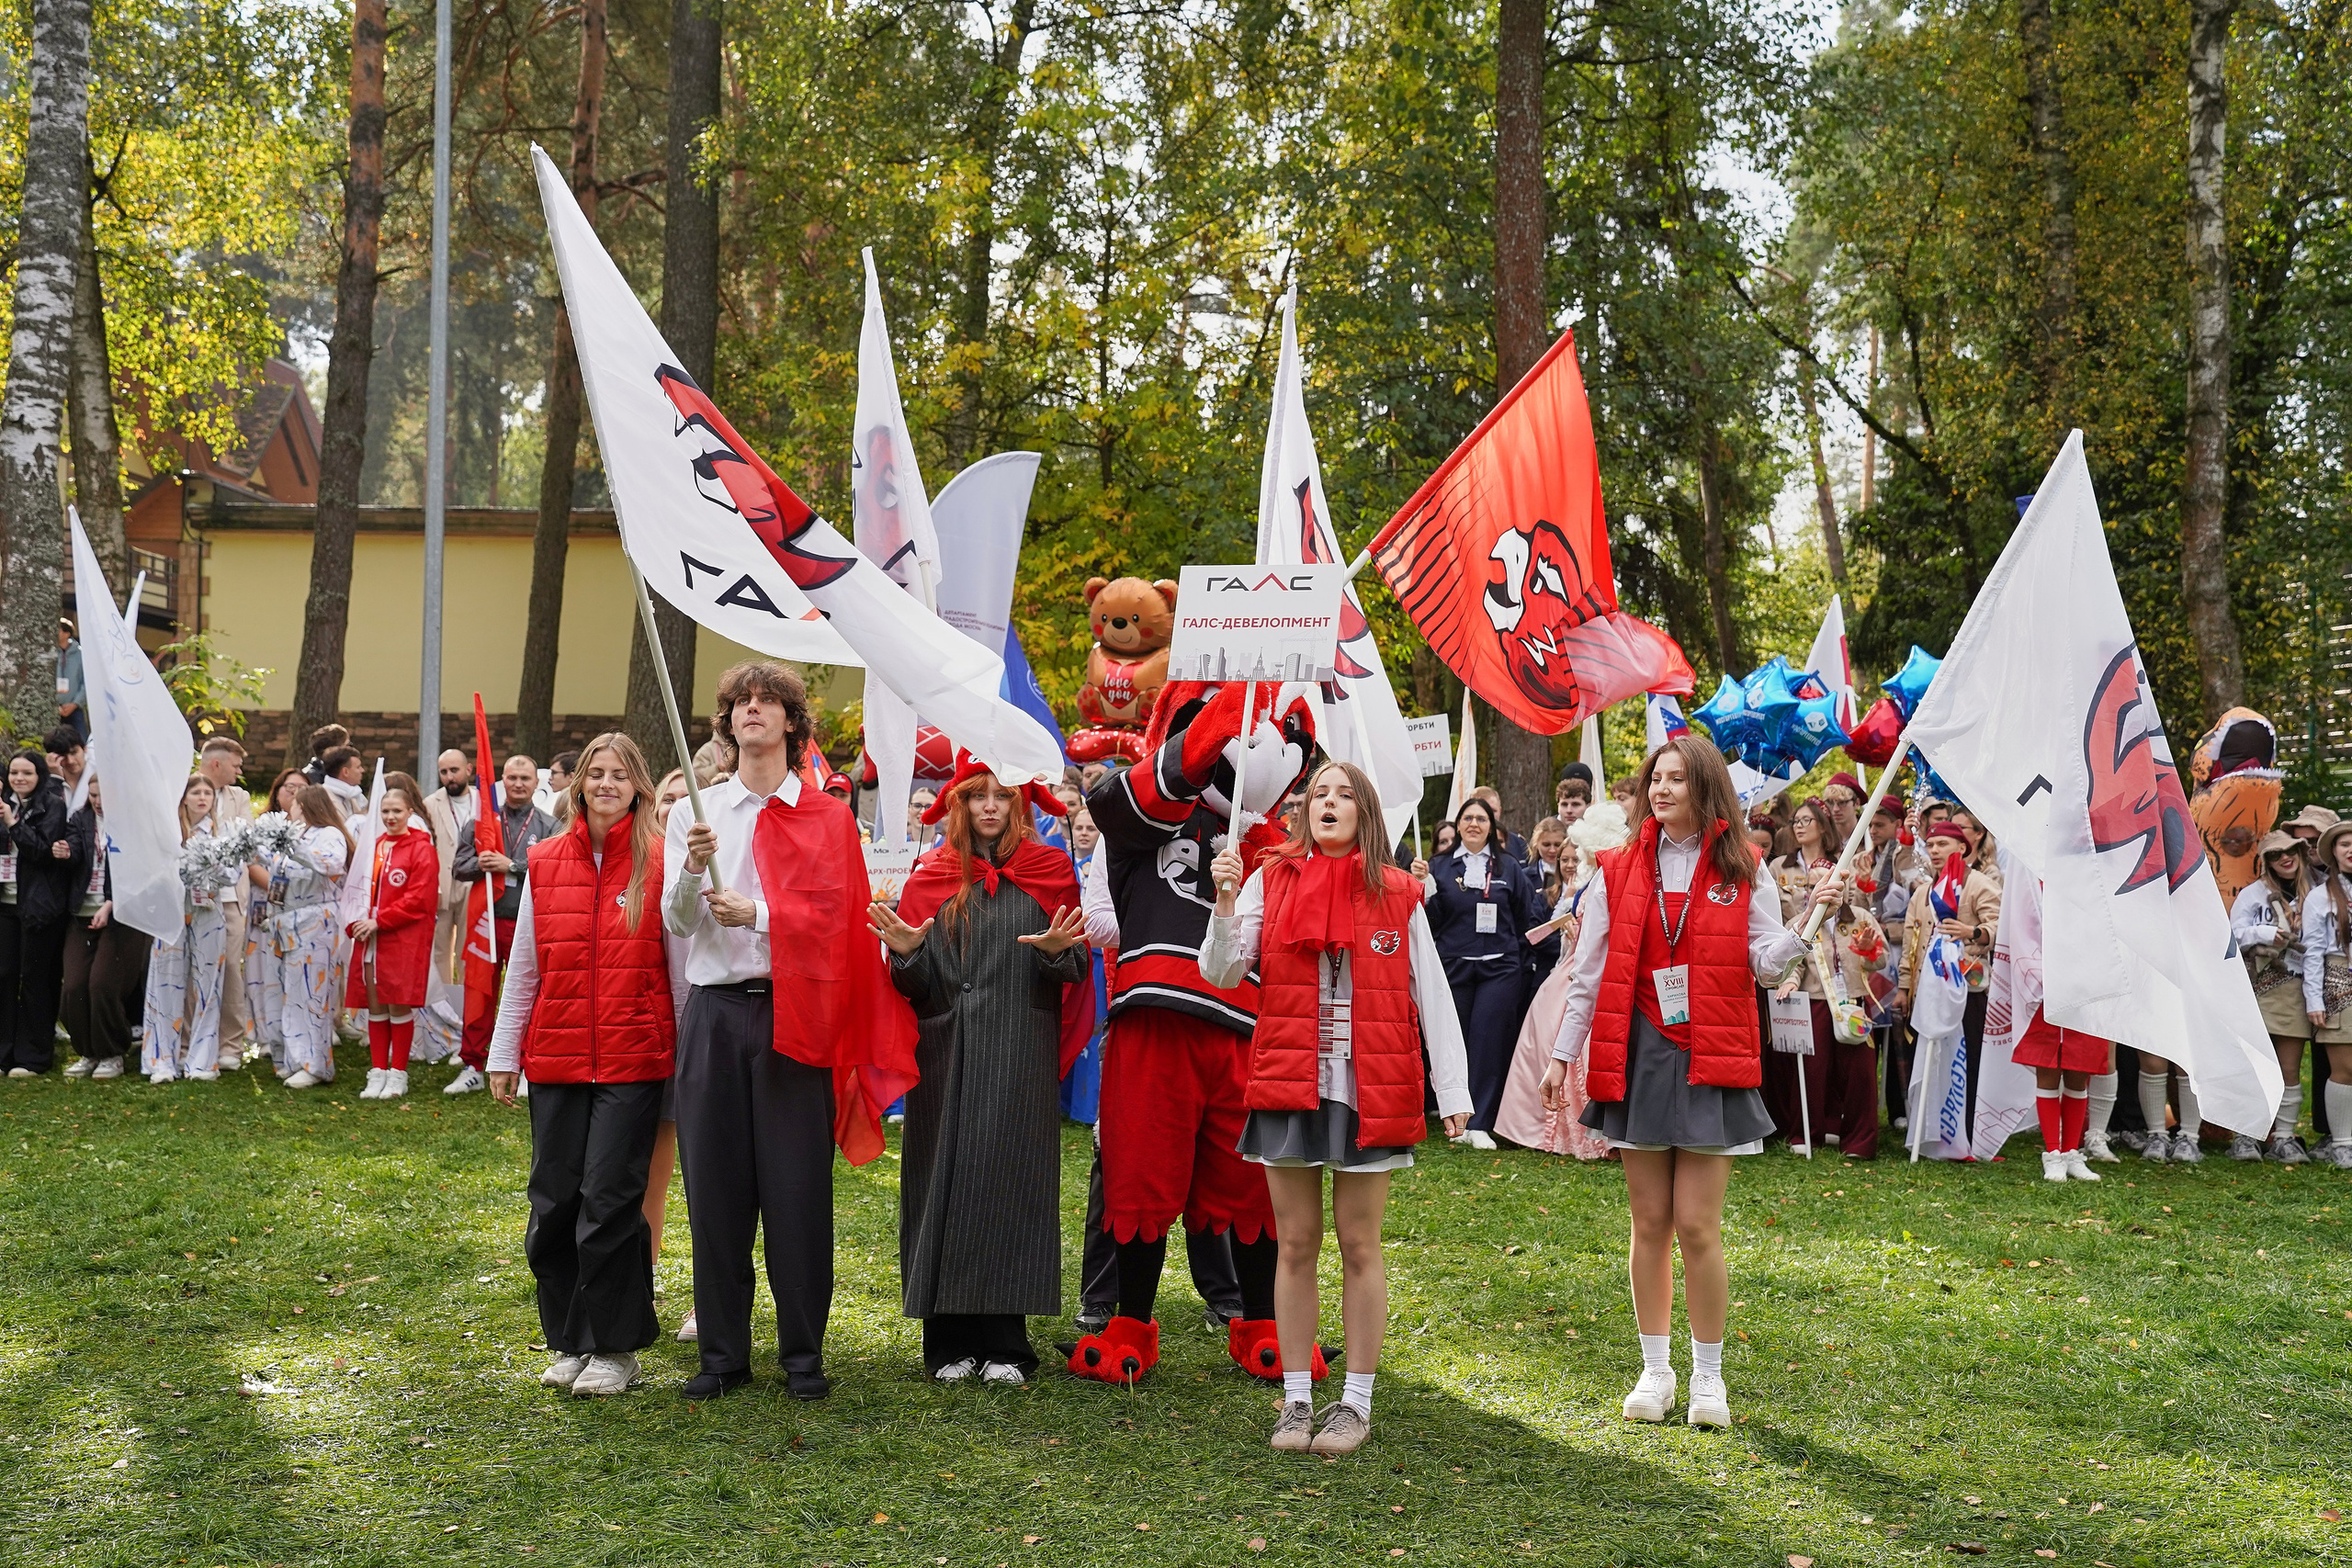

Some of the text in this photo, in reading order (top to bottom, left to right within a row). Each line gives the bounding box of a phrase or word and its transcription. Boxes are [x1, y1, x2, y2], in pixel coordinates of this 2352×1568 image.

[1206, 572, 1314, 592] ГАЛС
[1182, 616, 1331, 630] ГАЛС-ДЕВЕЛОПМЕНТ
[1104, 672, 1132, 689] love
[1108, 689, 1134, 703] you
[1406, 721, 1434, 731] ОРБТИ
[1414, 740, 1442, 751] РБТИ
[1664, 977, 1684, 987] XVIII
